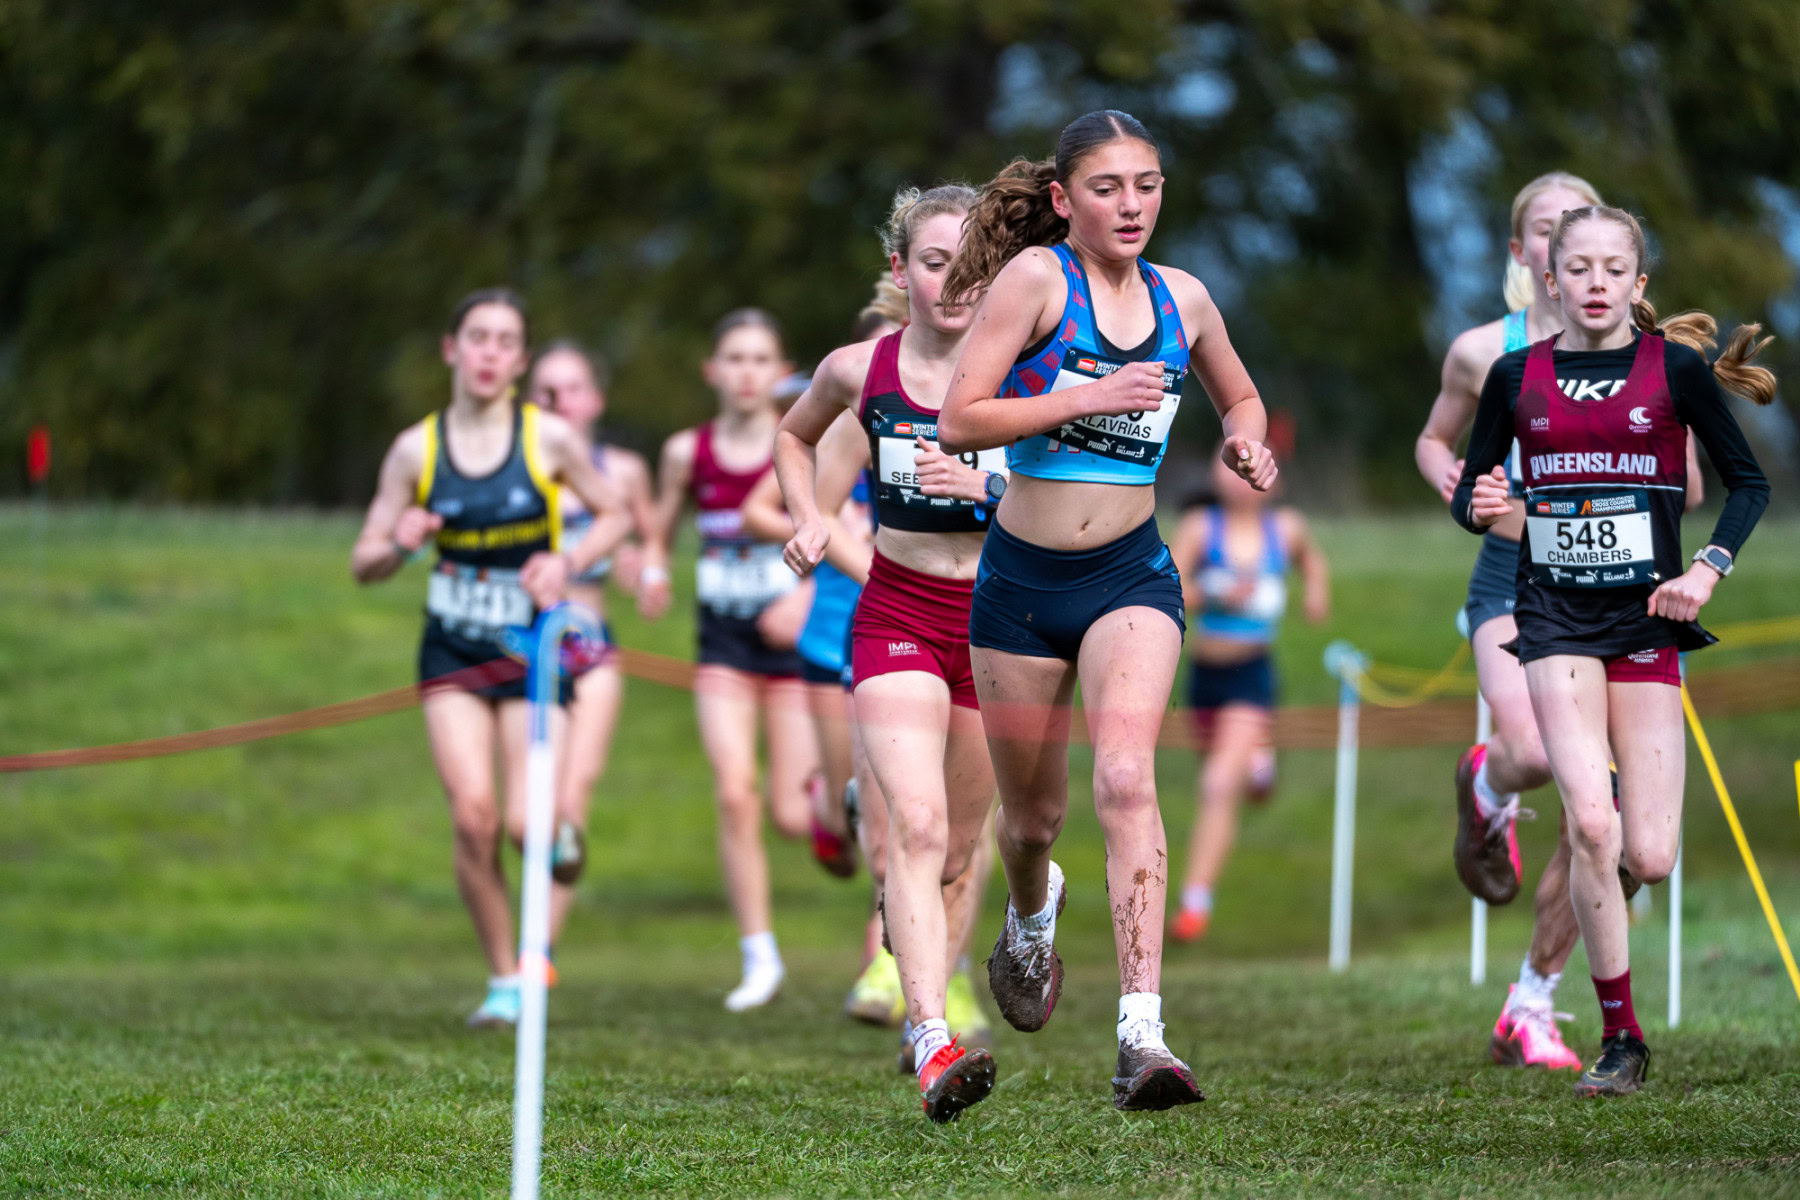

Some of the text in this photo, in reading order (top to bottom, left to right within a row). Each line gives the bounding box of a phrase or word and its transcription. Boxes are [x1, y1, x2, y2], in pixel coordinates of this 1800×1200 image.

[1556, 379, 1627, 401] IK
[1080, 415, 1152, 438] LAVRIAS
[1530, 417, 1549, 426] IMPI
[1087, 440, 1108, 452] PUMA
[1530, 452, 1657, 480] QUEENSLAND
[931, 498, 951, 506] PUMA
[1609, 498, 1636, 506] COUNTRY
[1591, 504, 1636, 512] CHAMPIONSHIPS
[1556, 519, 1618, 551] 548
[1547, 548, 1633, 564] CHAMBERS
[1576, 575, 1596, 583] PUMA
[888, 641, 918, 652] IMPI
